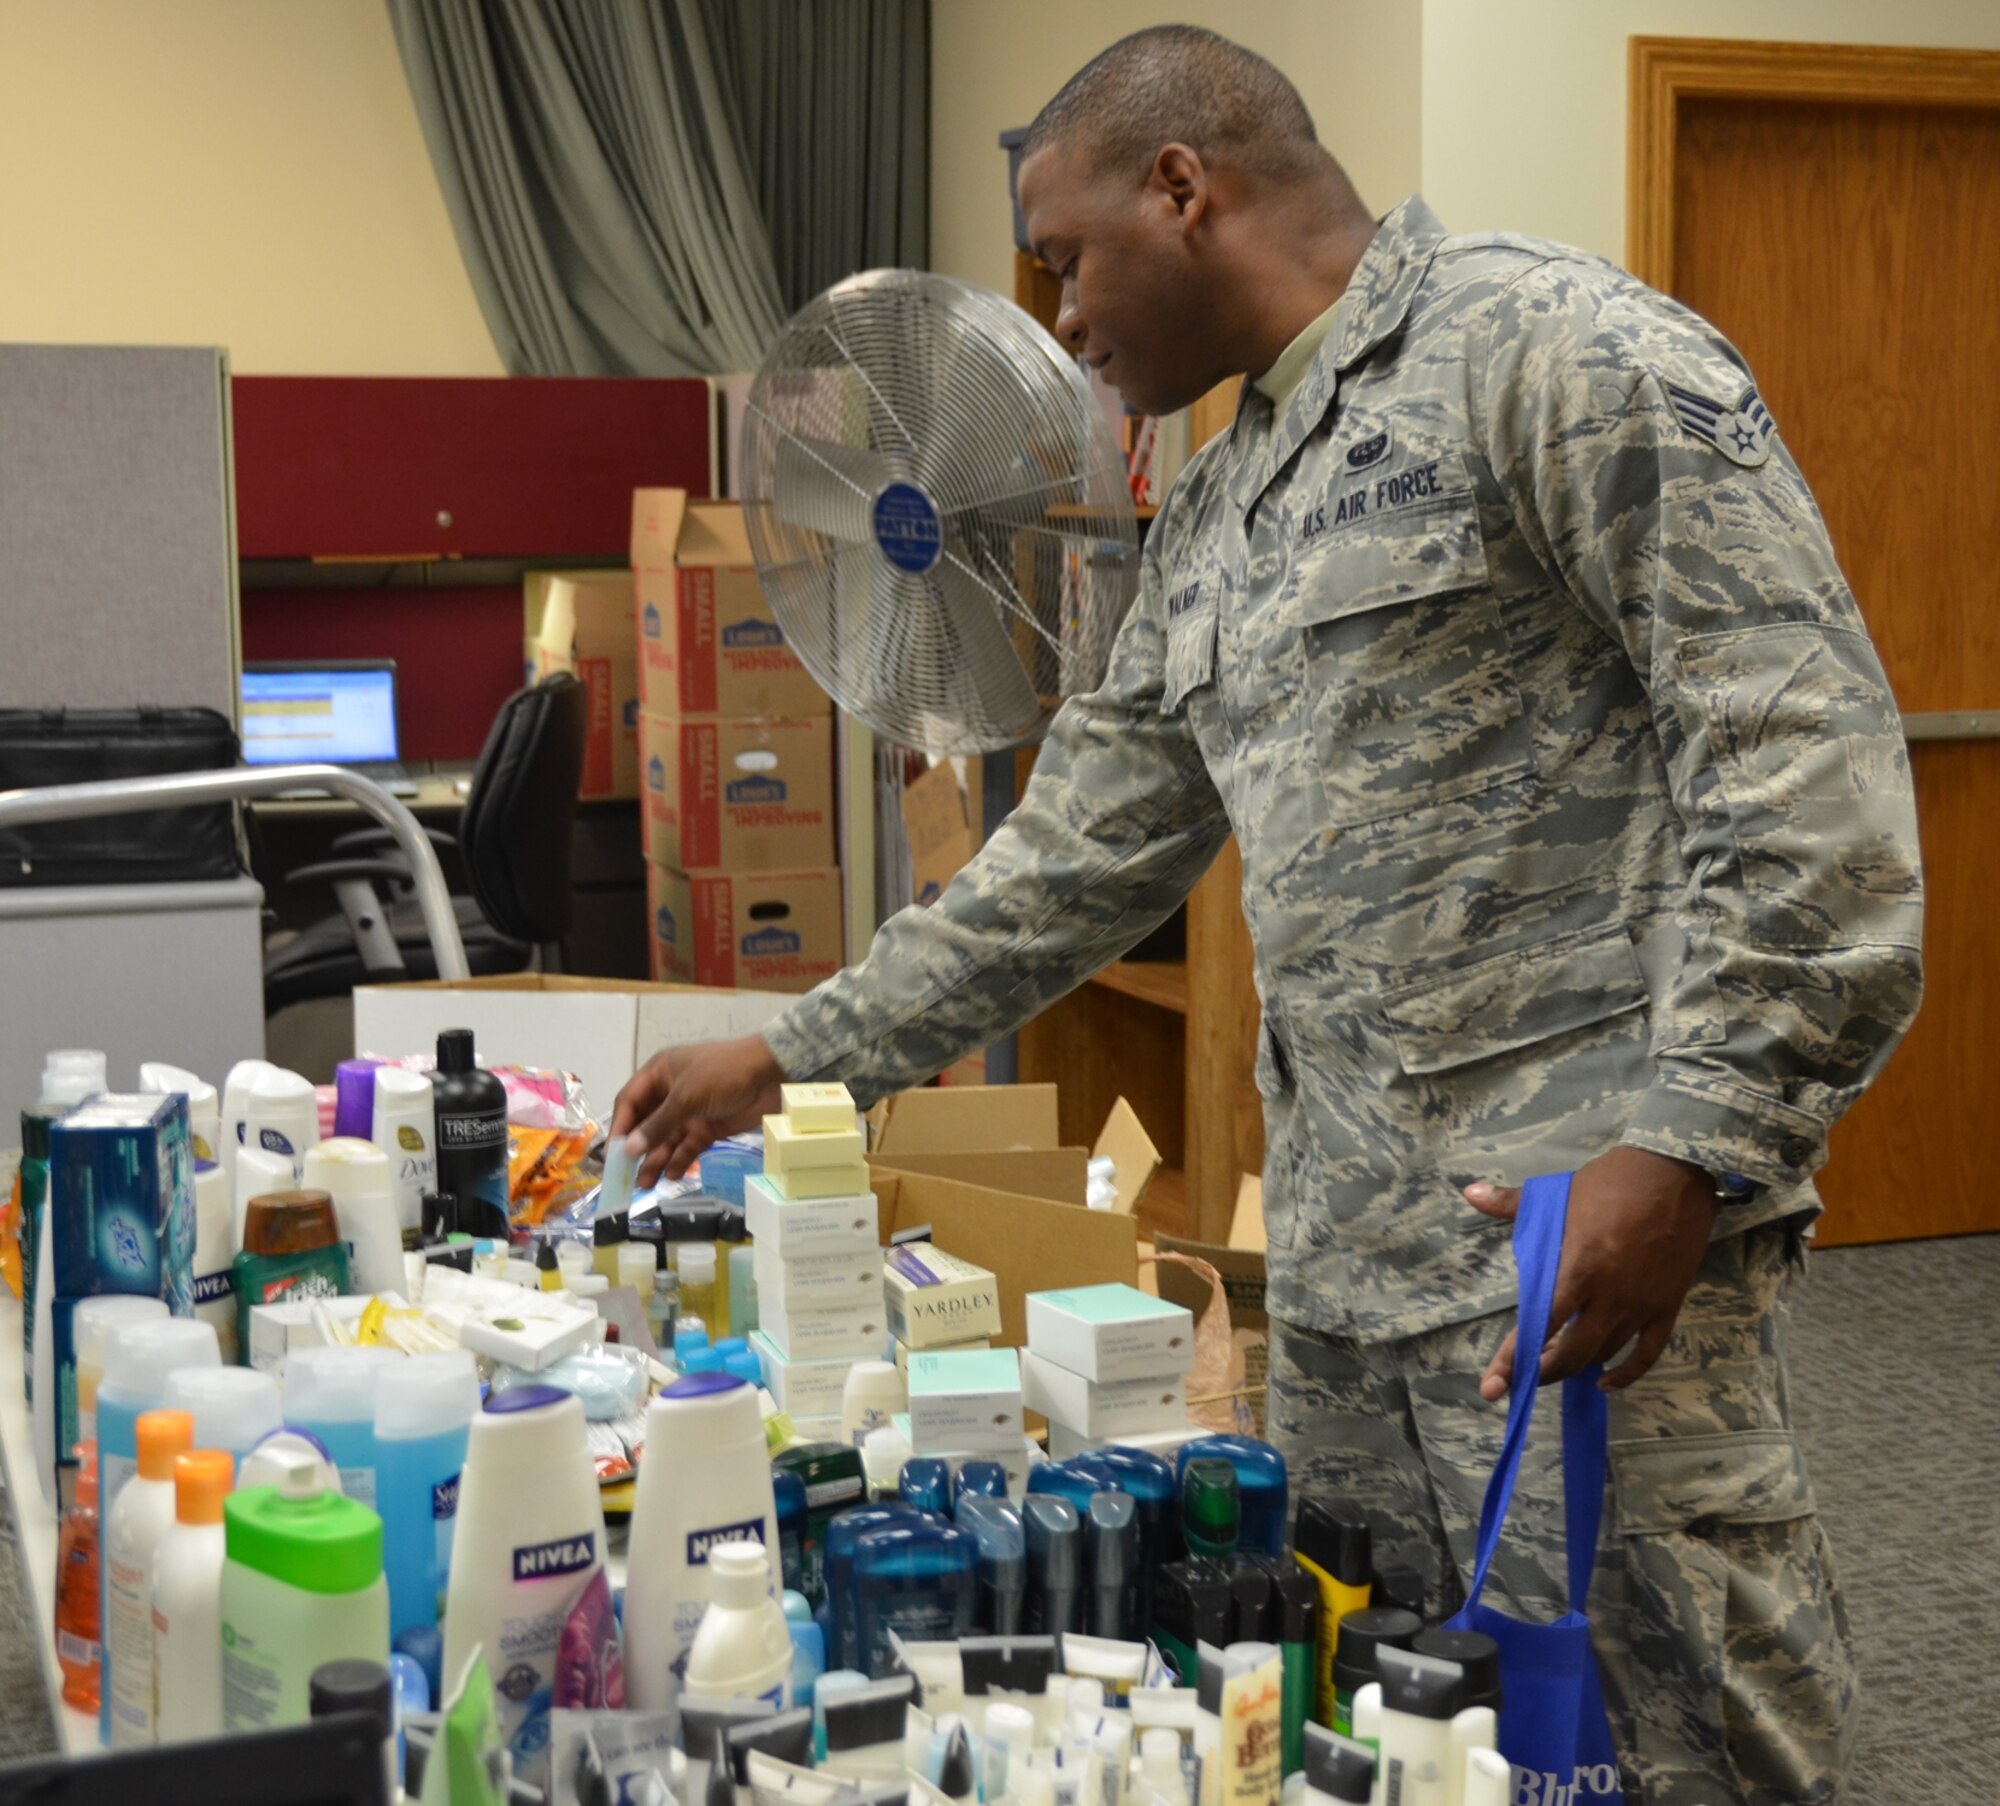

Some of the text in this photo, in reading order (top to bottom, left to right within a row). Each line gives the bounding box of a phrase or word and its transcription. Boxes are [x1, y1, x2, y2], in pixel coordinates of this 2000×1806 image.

[1303, 464, 1443, 538] U.S. AIR FORCE
[695, 572, 712, 648] SMALL
[592, 662, 609, 735] SMALL
[699, 727, 715, 805] SMALL
[713, 881, 730, 957] SMALL
[400, 1157, 436, 1180] Dove
[912, 1293, 995, 1319] YARDLEY
[519, 1541, 592, 1575] NIVEA
[1509, 1763, 1576, 1806] Blu
